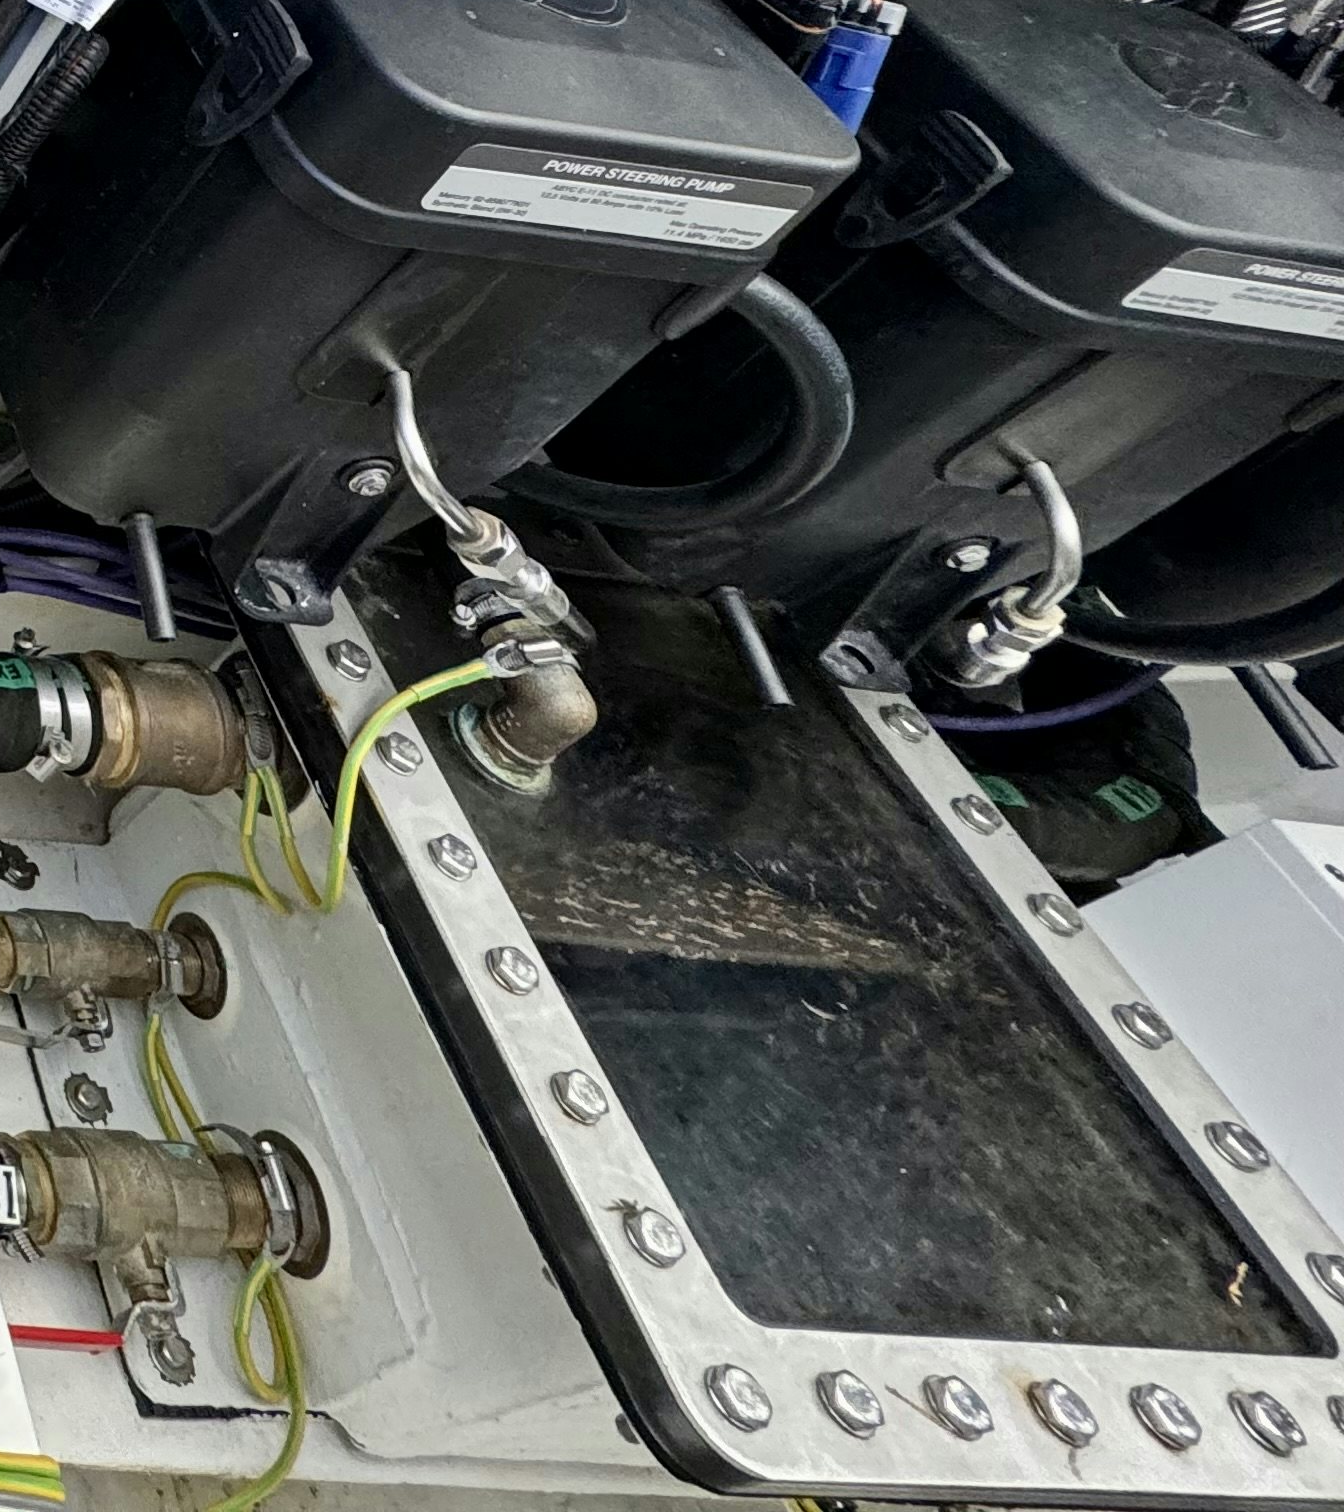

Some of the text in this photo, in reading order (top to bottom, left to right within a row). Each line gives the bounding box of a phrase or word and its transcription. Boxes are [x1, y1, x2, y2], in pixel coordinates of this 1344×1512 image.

[542, 159, 736, 194] POWER STEERING PUMP
[1243, 263, 1300, 280] POWER
